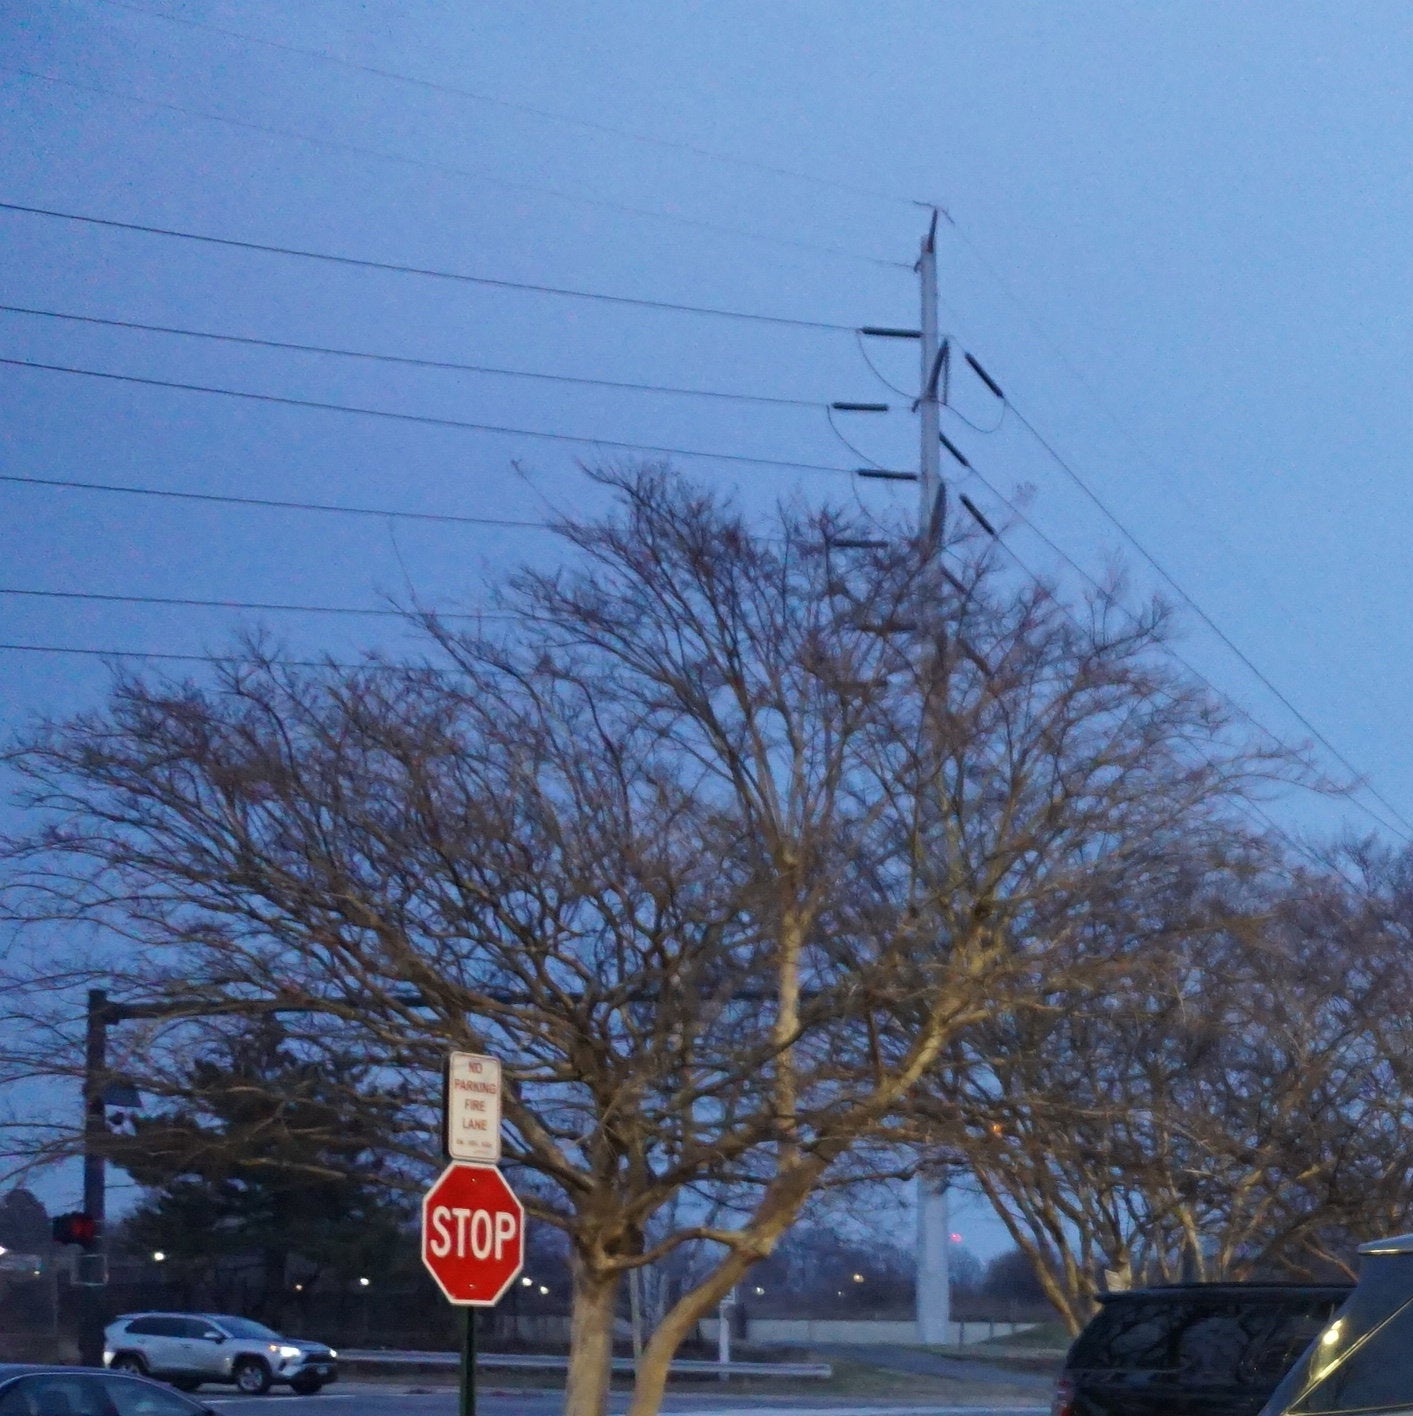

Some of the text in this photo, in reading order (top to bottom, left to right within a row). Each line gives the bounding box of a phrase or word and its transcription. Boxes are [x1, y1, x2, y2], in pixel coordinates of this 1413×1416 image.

[468, 1061, 483, 1074] NO
[454, 1079, 496, 1095] PARKING
[464, 1099, 485, 1112] FIRE
[463, 1119, 487, 1131] LANE
[430, 1206, 516, 1260] STOP
